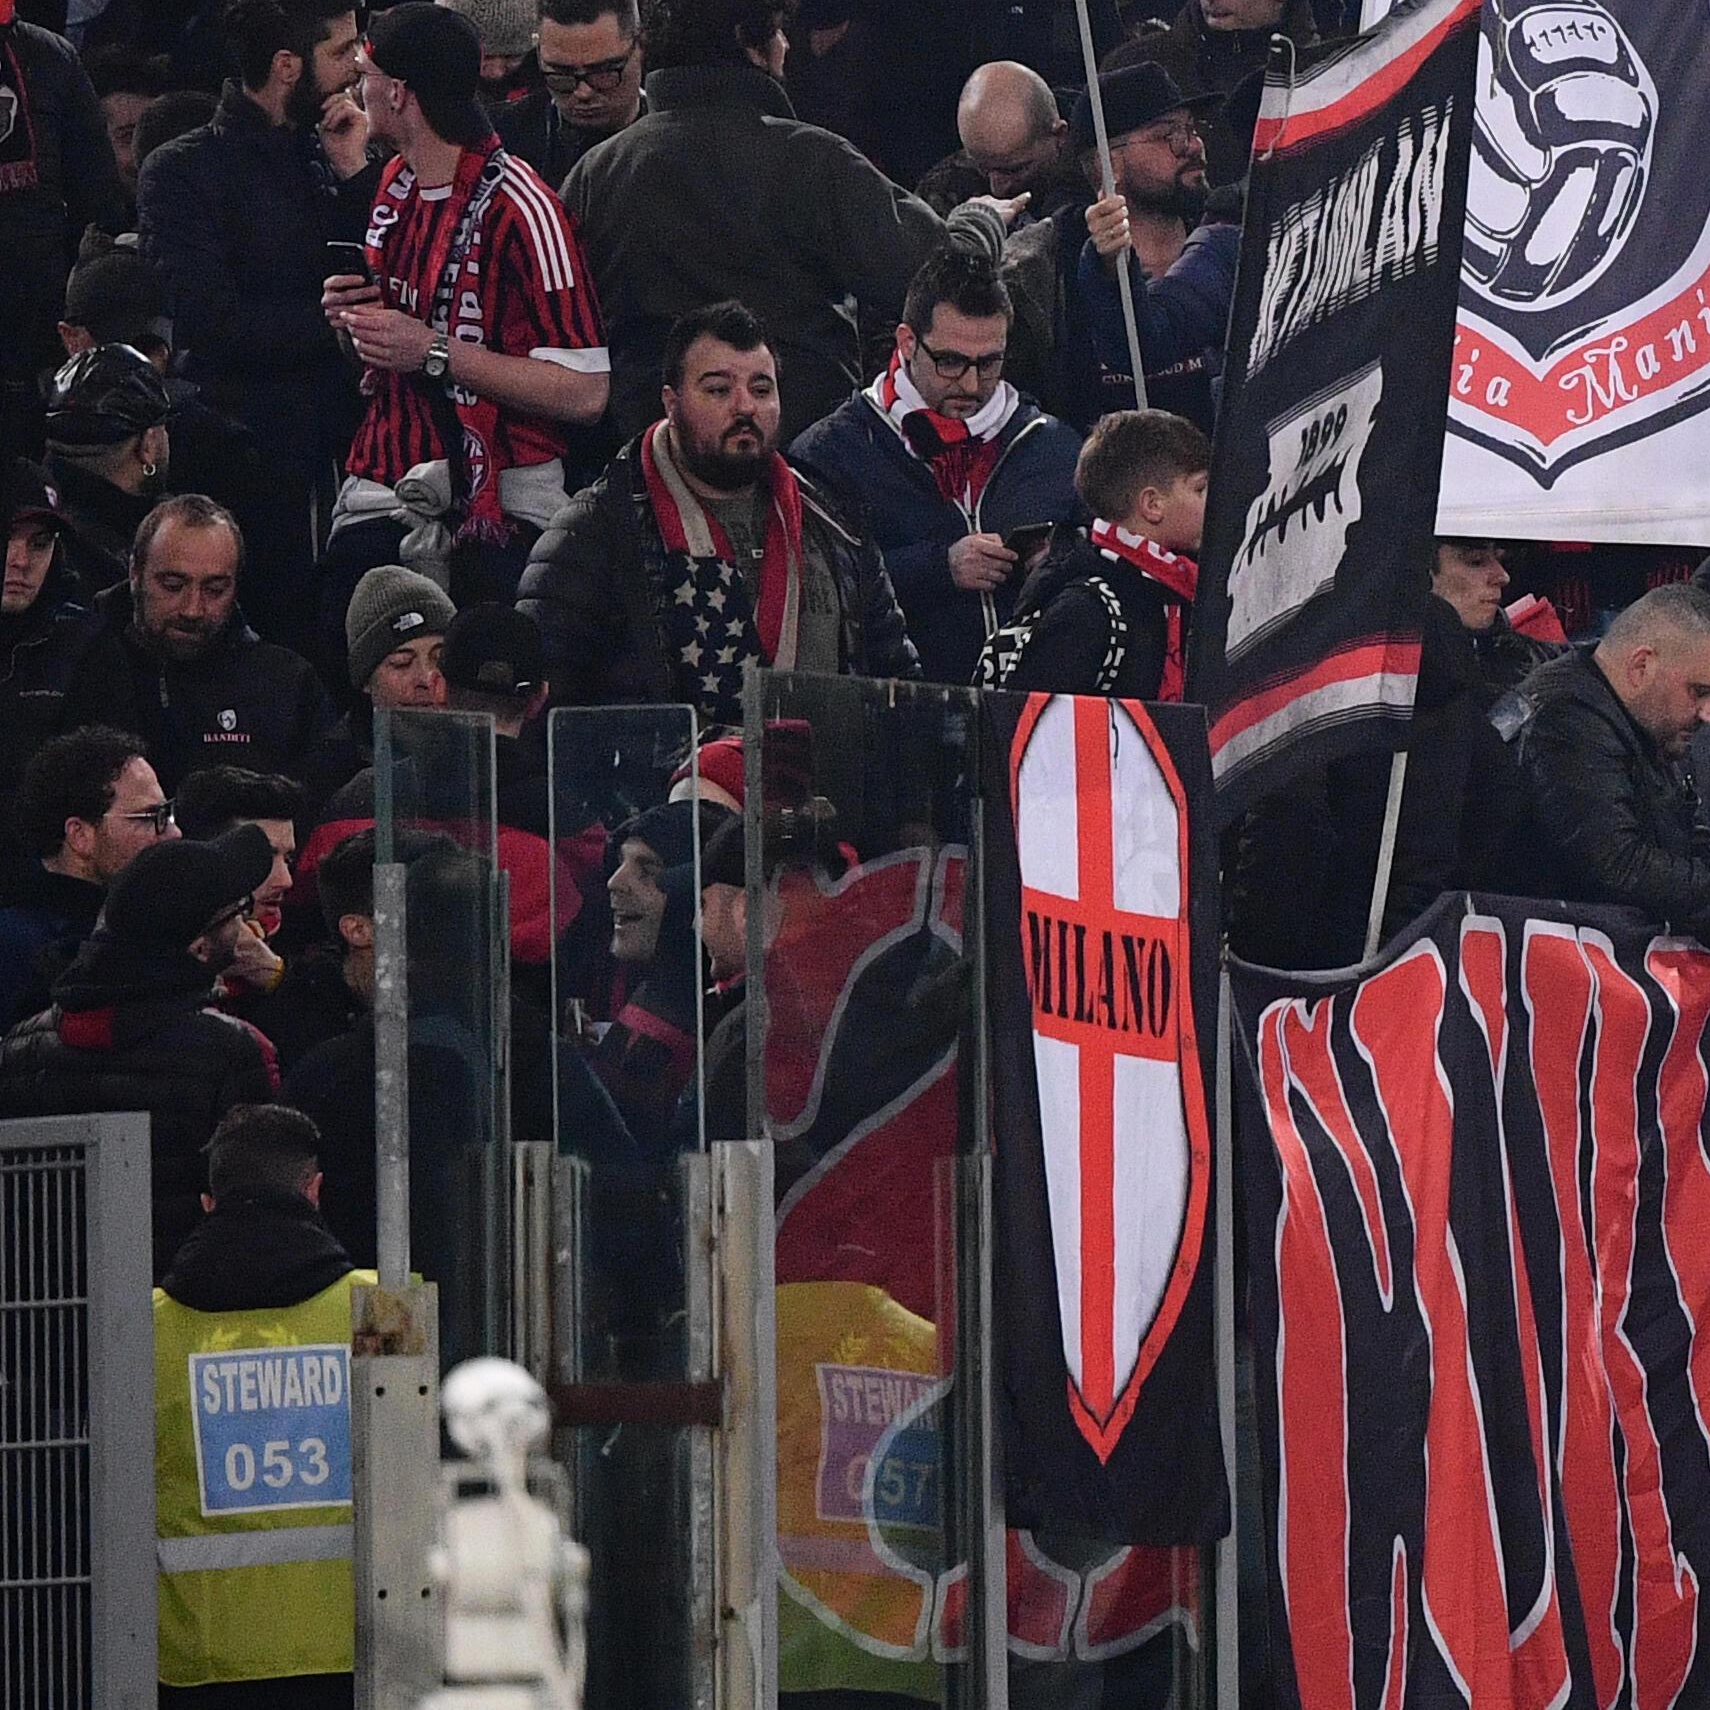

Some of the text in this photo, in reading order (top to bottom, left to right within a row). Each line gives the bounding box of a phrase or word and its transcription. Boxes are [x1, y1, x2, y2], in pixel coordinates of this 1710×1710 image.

[1301, 402, 1348, 465] 1899
[1027, 909, 1173, 1040] MILANO
[202, 1351, 343, 1415] STEWARD
[225, 1436, 332, 1493] 053
